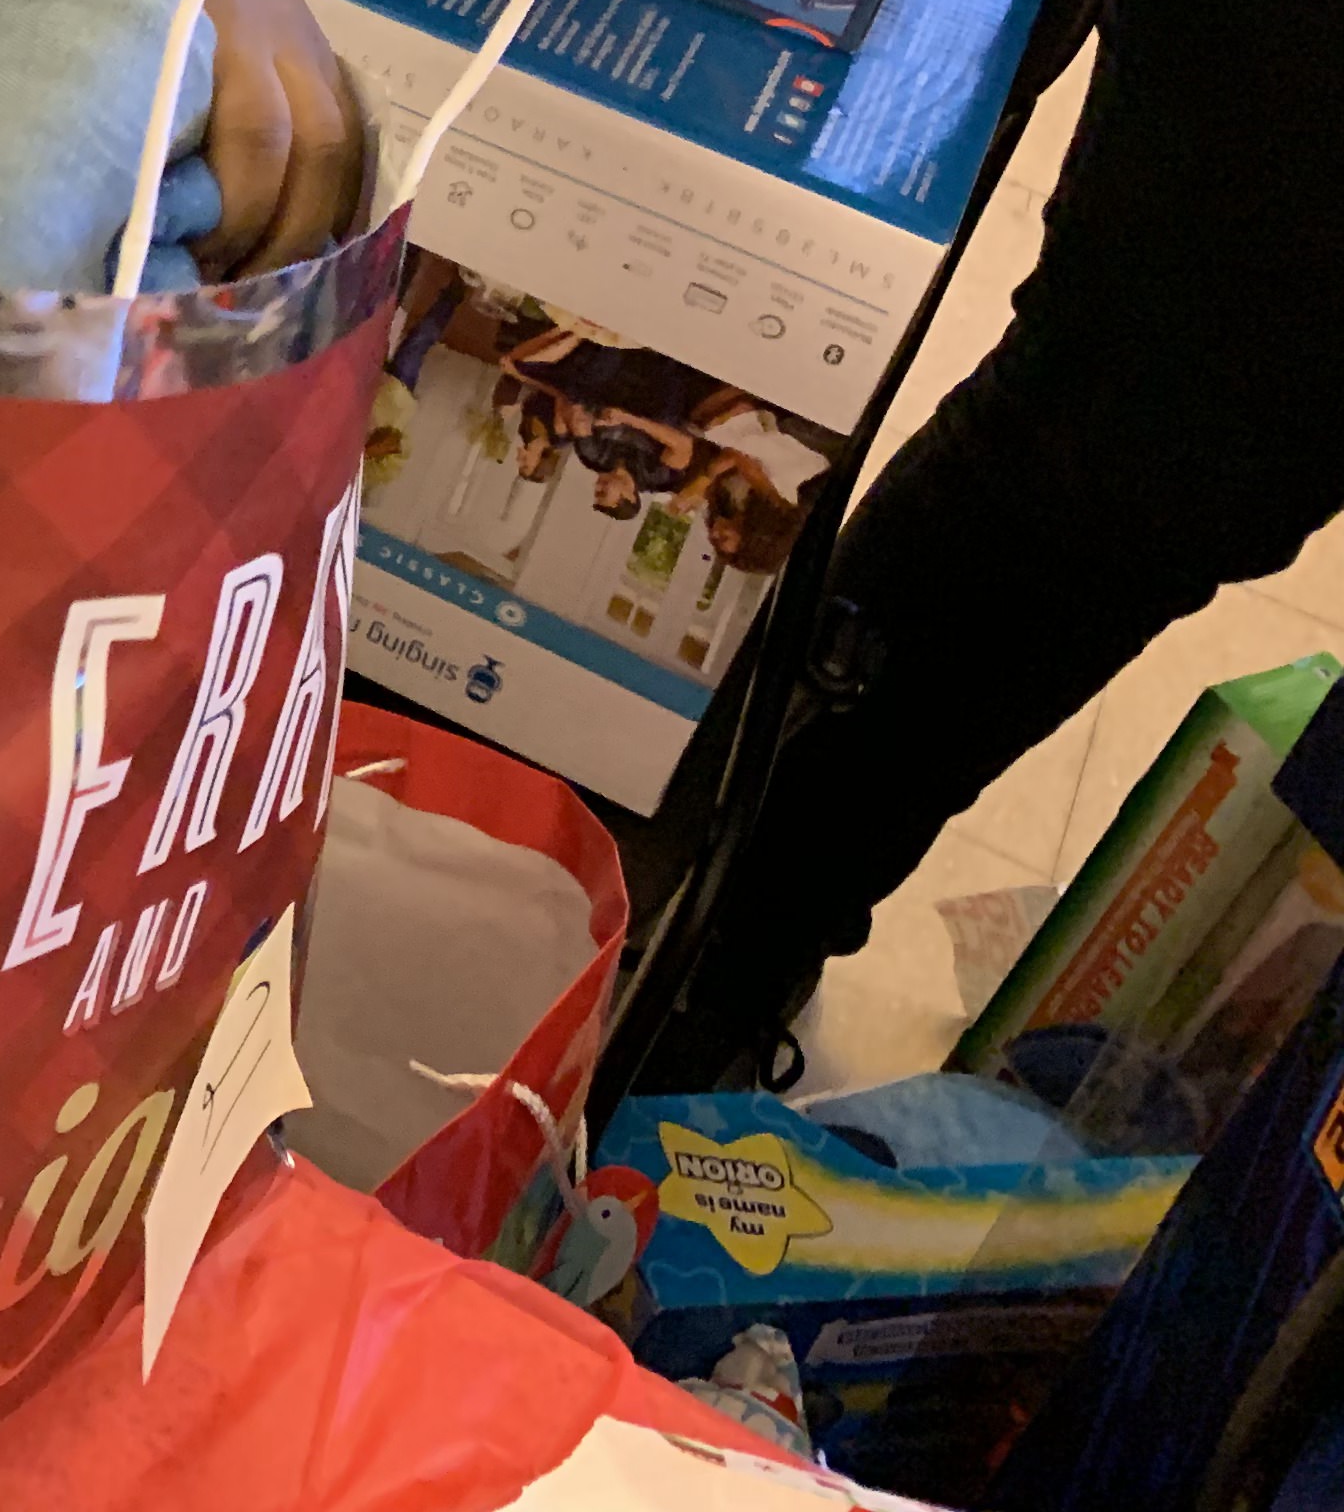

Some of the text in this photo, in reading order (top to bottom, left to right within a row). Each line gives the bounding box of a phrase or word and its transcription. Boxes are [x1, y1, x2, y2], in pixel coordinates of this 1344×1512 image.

[376, 544, 487, 607] CLASSIC
[362, 619, 462, 687] singing
[1143, 828, 1225, 923] READY
[62, 880, 208, 1037] AND
[1118, 914, 1162, 960] TO
[693, 1193, 785, 1219] name is
[729, 1215, 765, 1236] my
